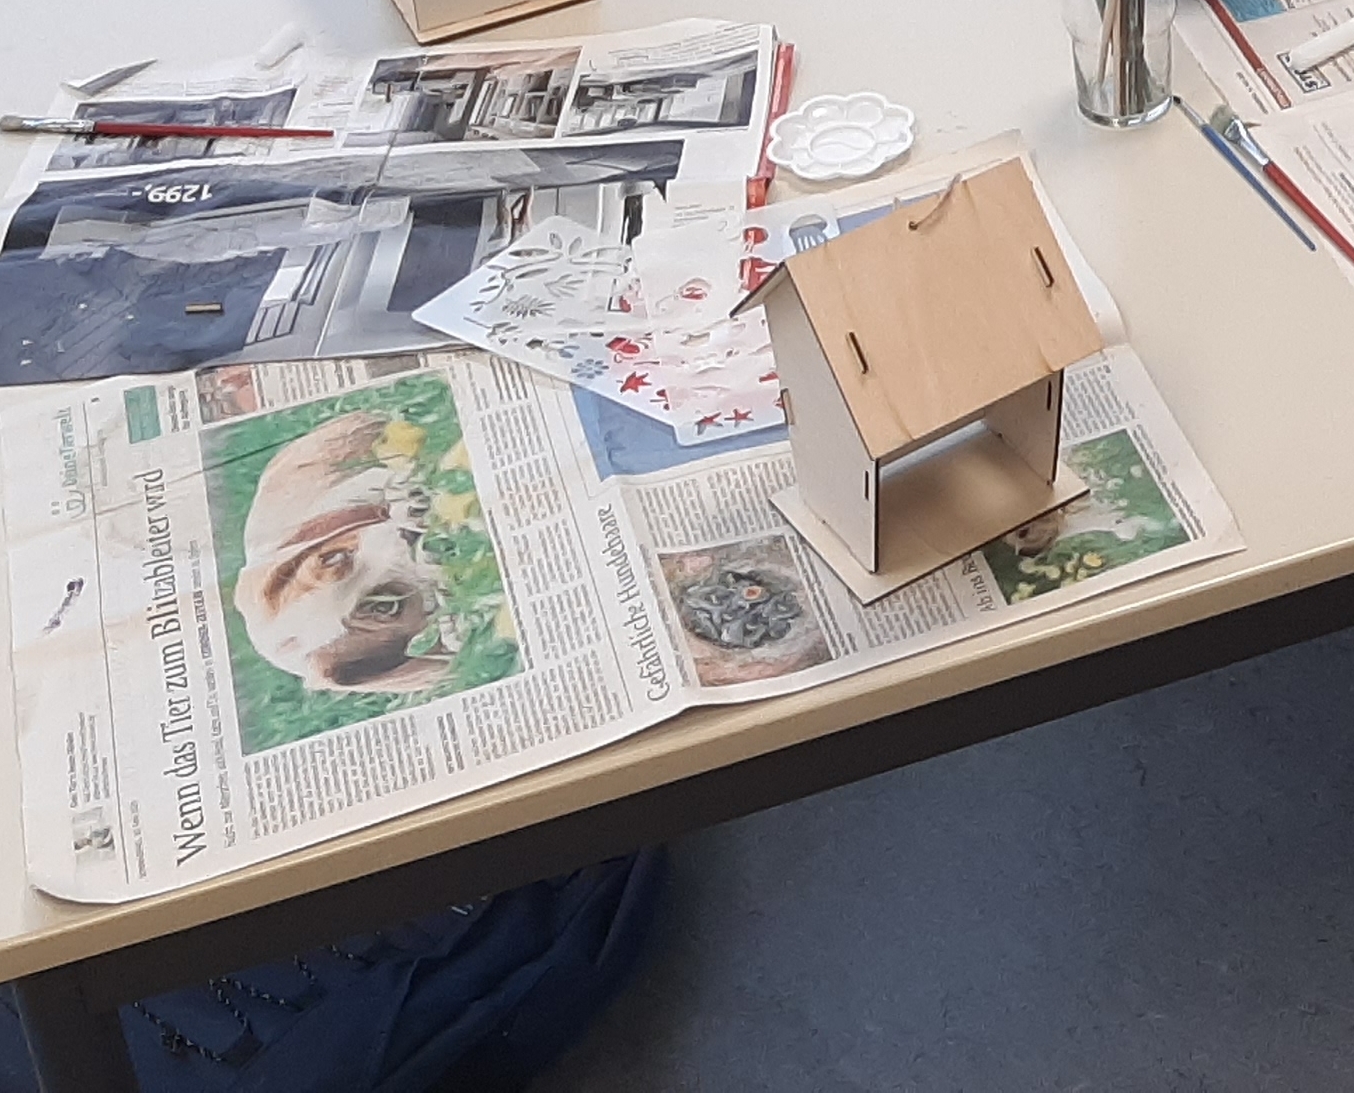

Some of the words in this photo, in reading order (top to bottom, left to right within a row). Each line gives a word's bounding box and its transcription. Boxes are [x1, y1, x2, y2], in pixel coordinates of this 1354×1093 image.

[132, 468, 167, 513] wird
[142, 515, 182, 640] Blitzableiter
[598, 503, 641, 603] Hundehaare
[161, 639, 190, 692] zum
[623, 601, 670, 702] Gefährliche
[160, 695, 194, 743] Tier
[163, 741, 198, 778] das
[173, 782, 208, 868] Wenn
